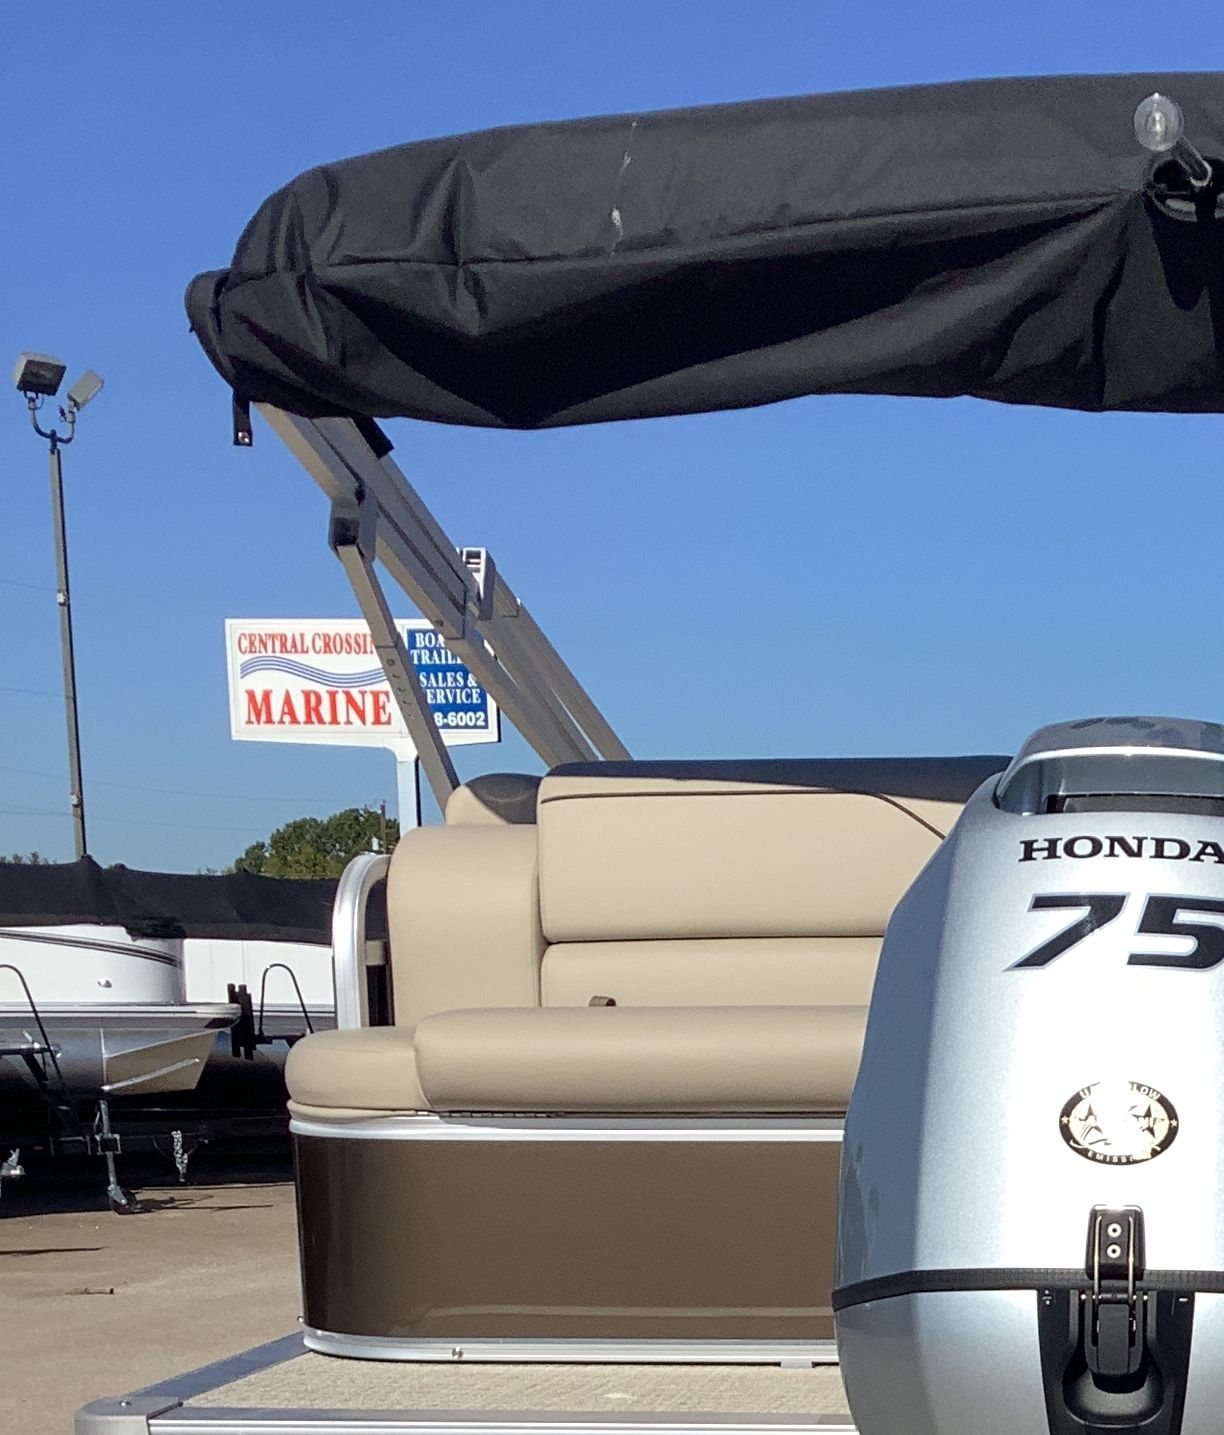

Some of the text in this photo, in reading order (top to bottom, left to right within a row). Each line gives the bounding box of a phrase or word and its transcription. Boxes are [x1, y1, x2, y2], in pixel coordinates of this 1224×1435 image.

[238, 632, 374, 655] CENTRAL CROSSI
[415, 632, 446, 648] BOA
[410, 649, 463, 665] TRAIL
[419, 671, 478, 688] SALES &
[425, 688, 482, 704] ERVICE
[245, 689, 392, 726] MARINE
[433, 711, 486, 727] 8-6002
